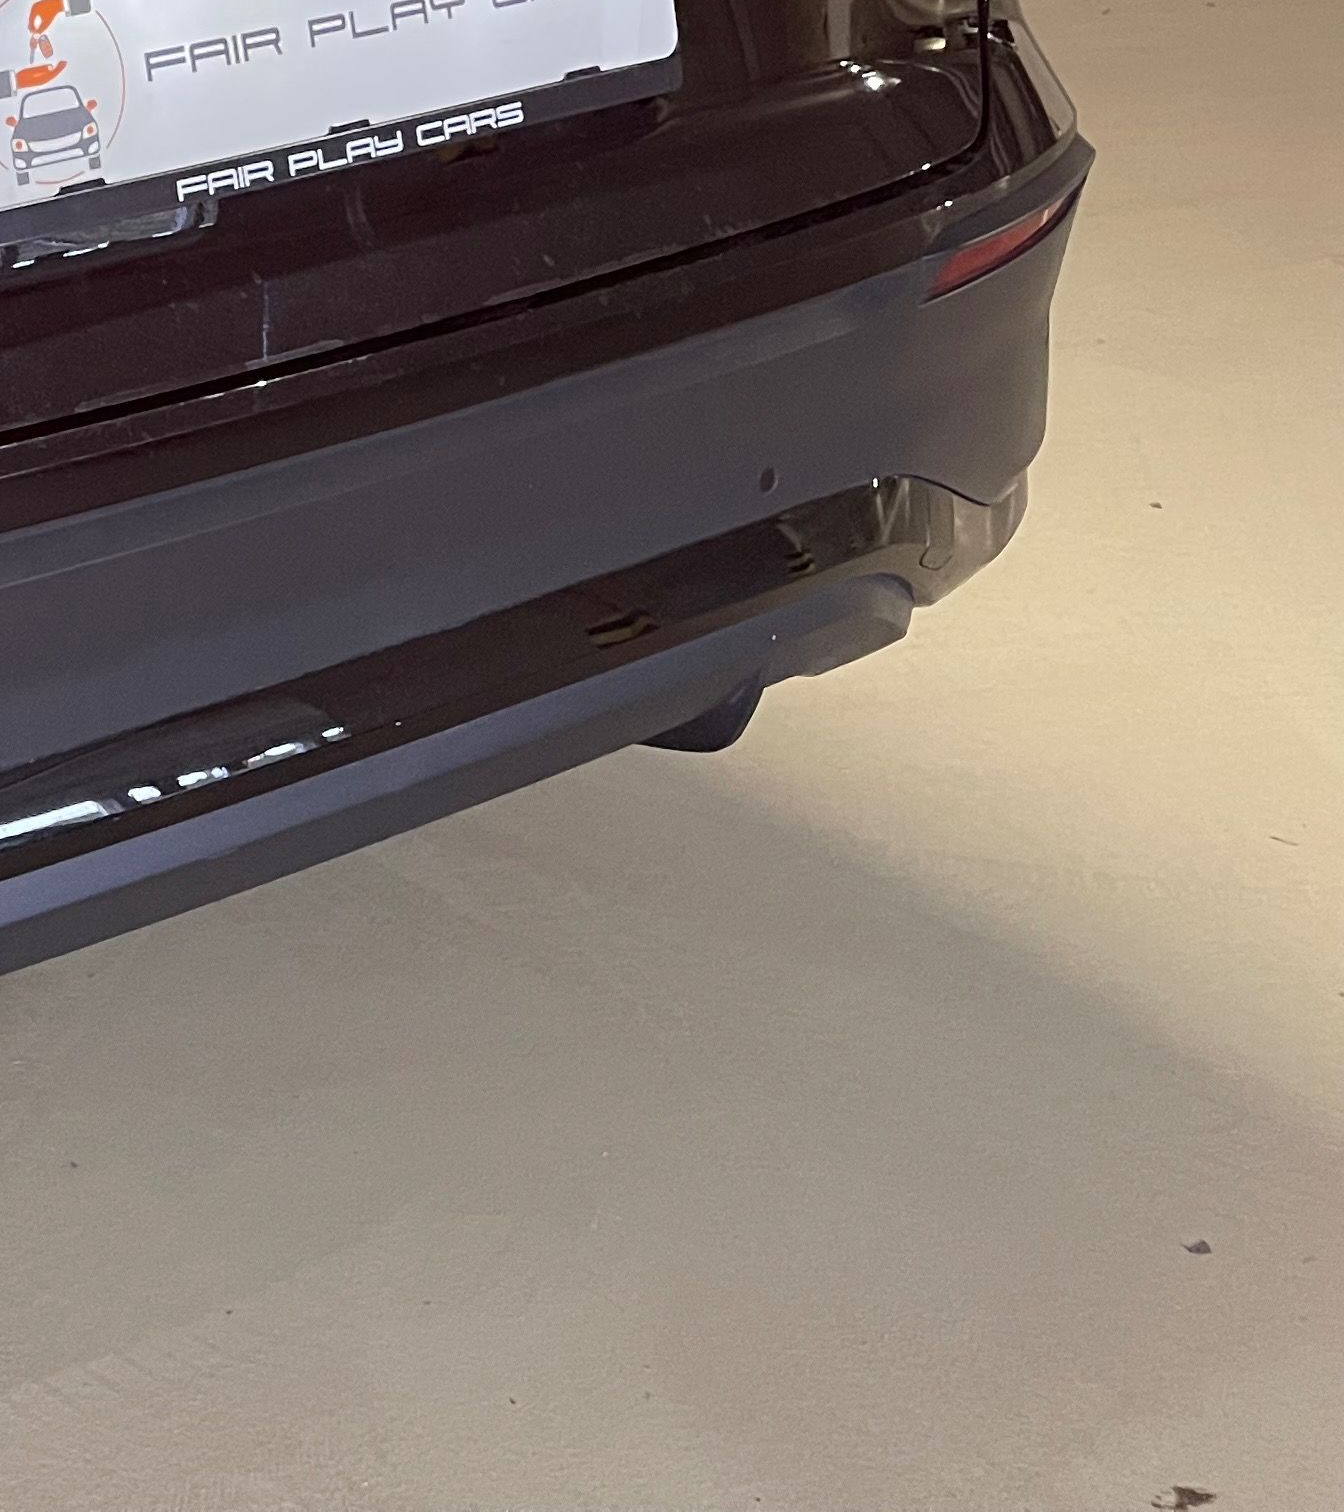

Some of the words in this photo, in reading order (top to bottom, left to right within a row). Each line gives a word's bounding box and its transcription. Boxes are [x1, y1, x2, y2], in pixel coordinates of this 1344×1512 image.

[144, 26, 283, 82] FAIR
[176, 159, 275, 202] FAIR
[287, 130, 405, 177] PLAY
[416, 101, 525, 147] CARS
